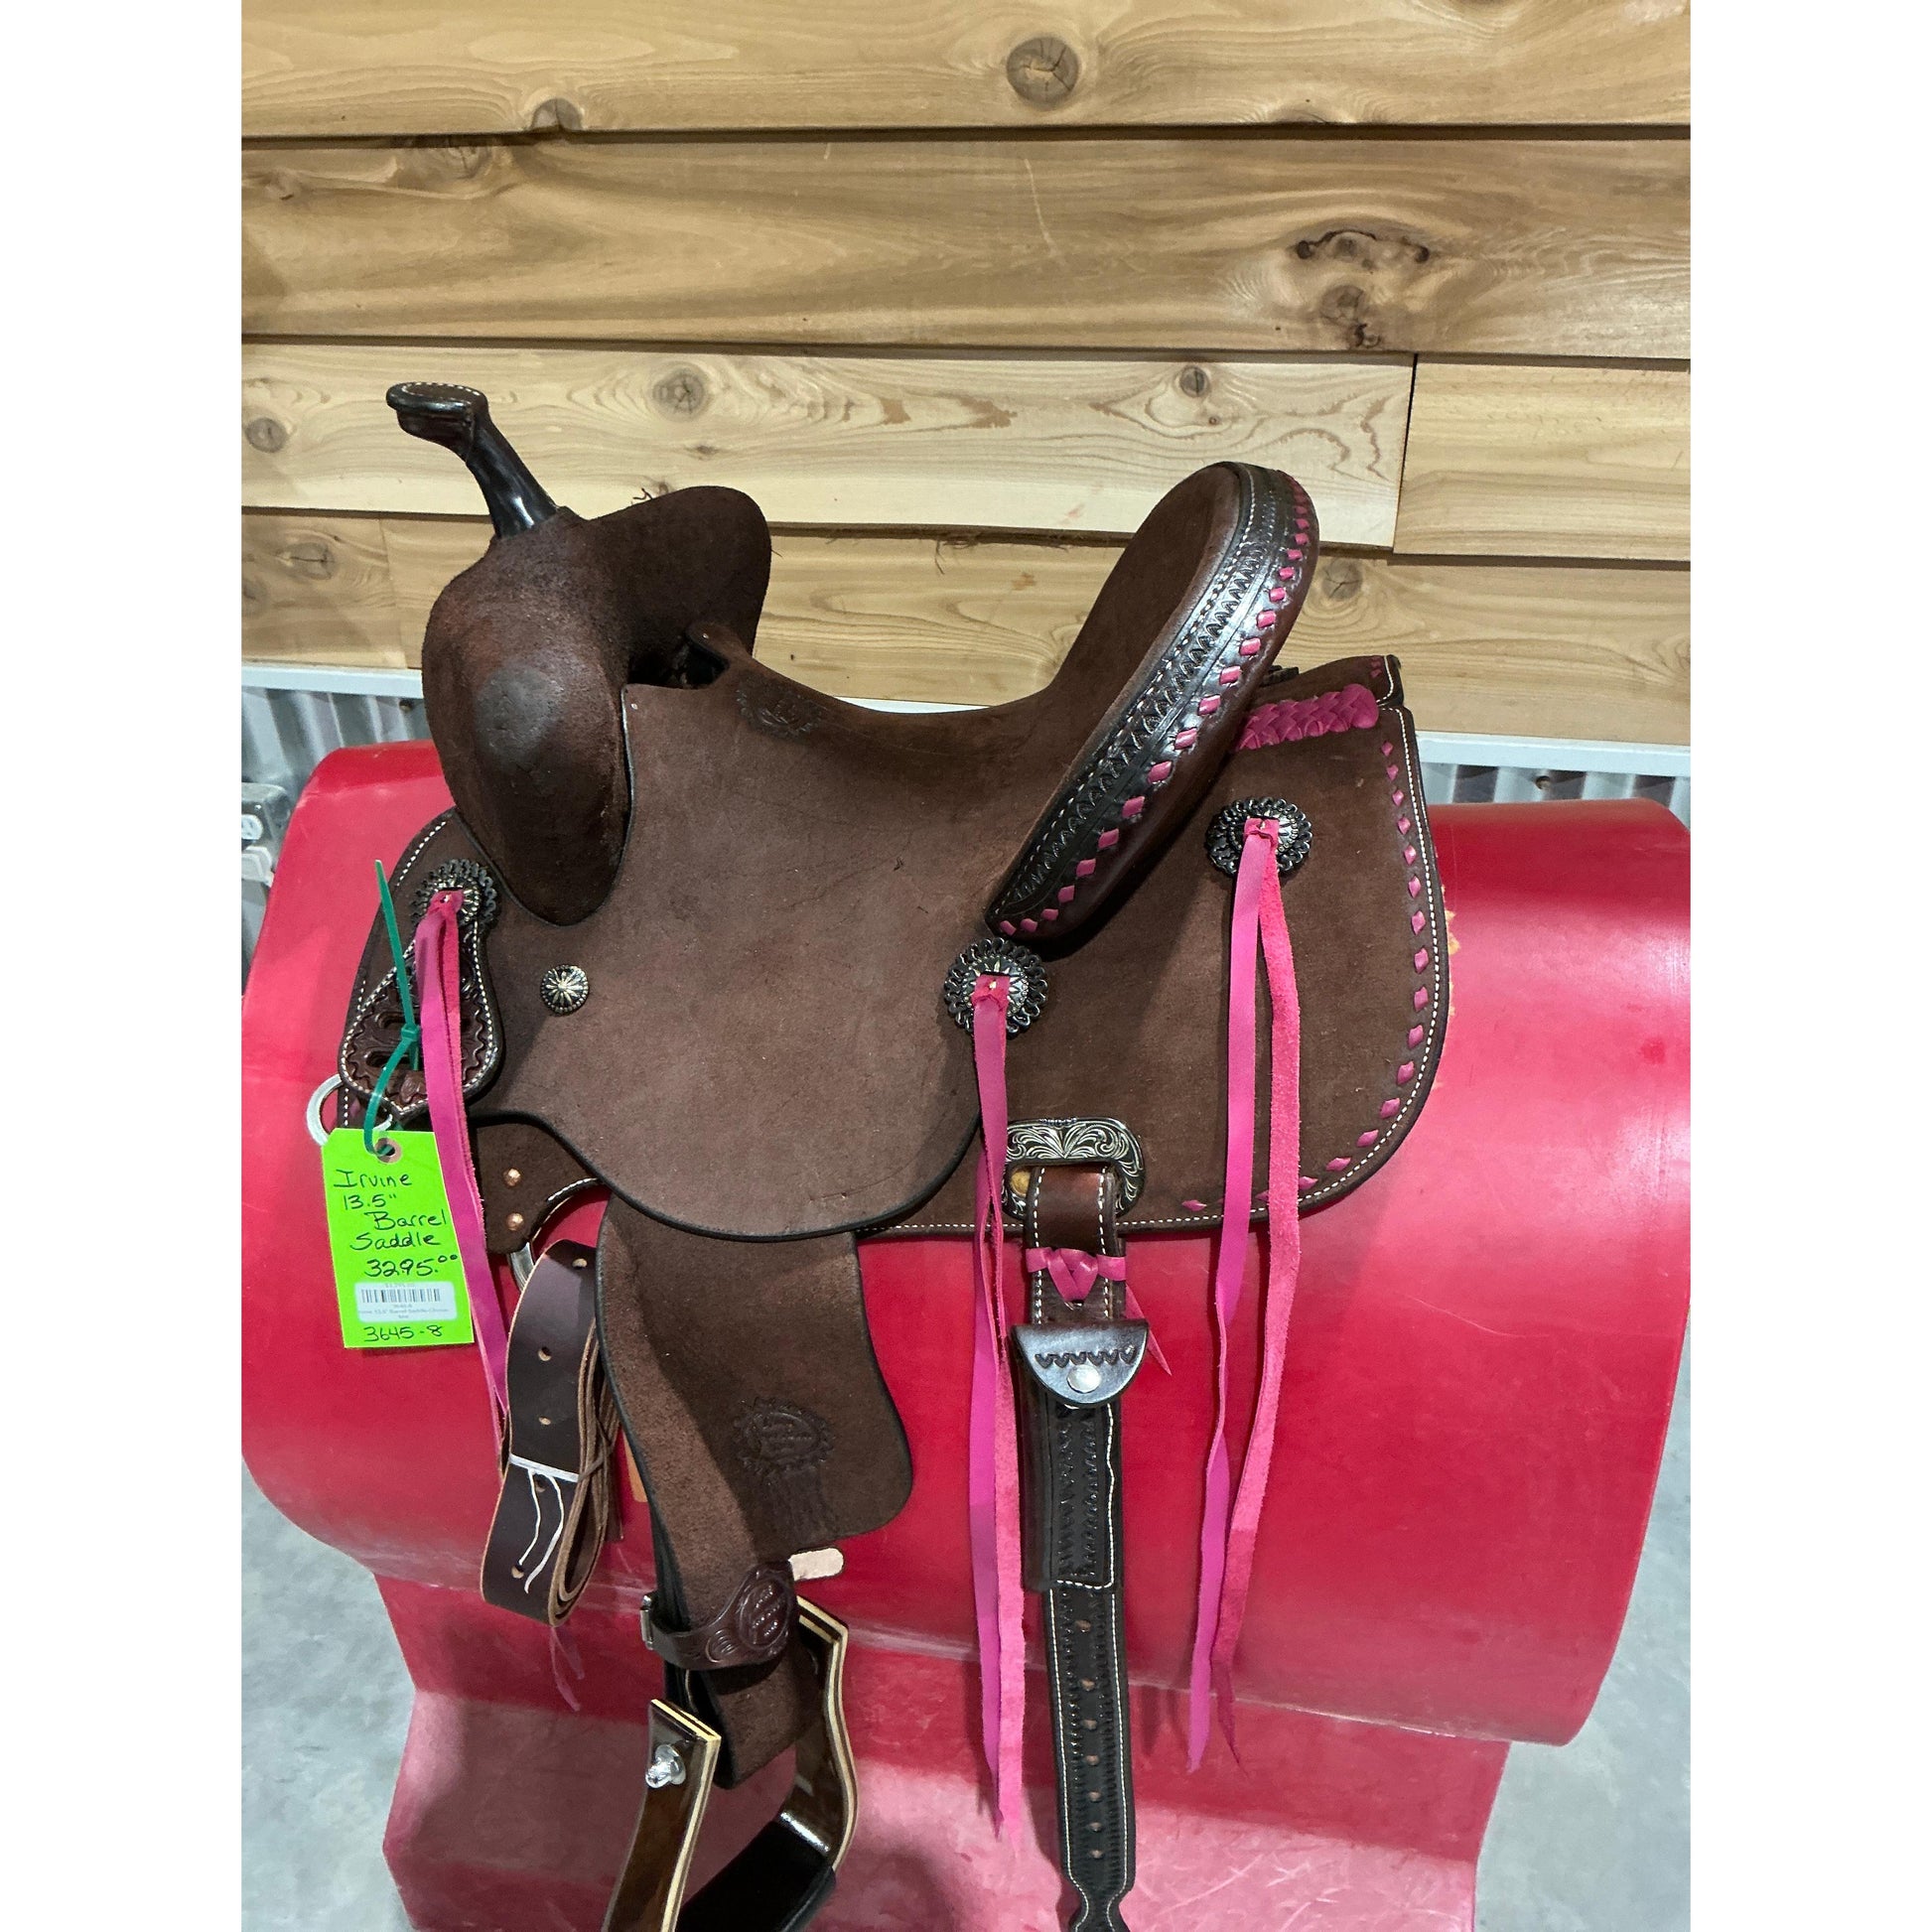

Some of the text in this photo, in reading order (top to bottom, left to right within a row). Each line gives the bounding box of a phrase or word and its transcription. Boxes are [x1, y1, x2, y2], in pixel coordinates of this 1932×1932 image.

[333, 1169, 412, 1187] Irvine
[344, 1193, 397, 1210] 13.5"
[363, 1208, 447, 1230] Barrel
[349, 1231, 441, 1251] Saddle
